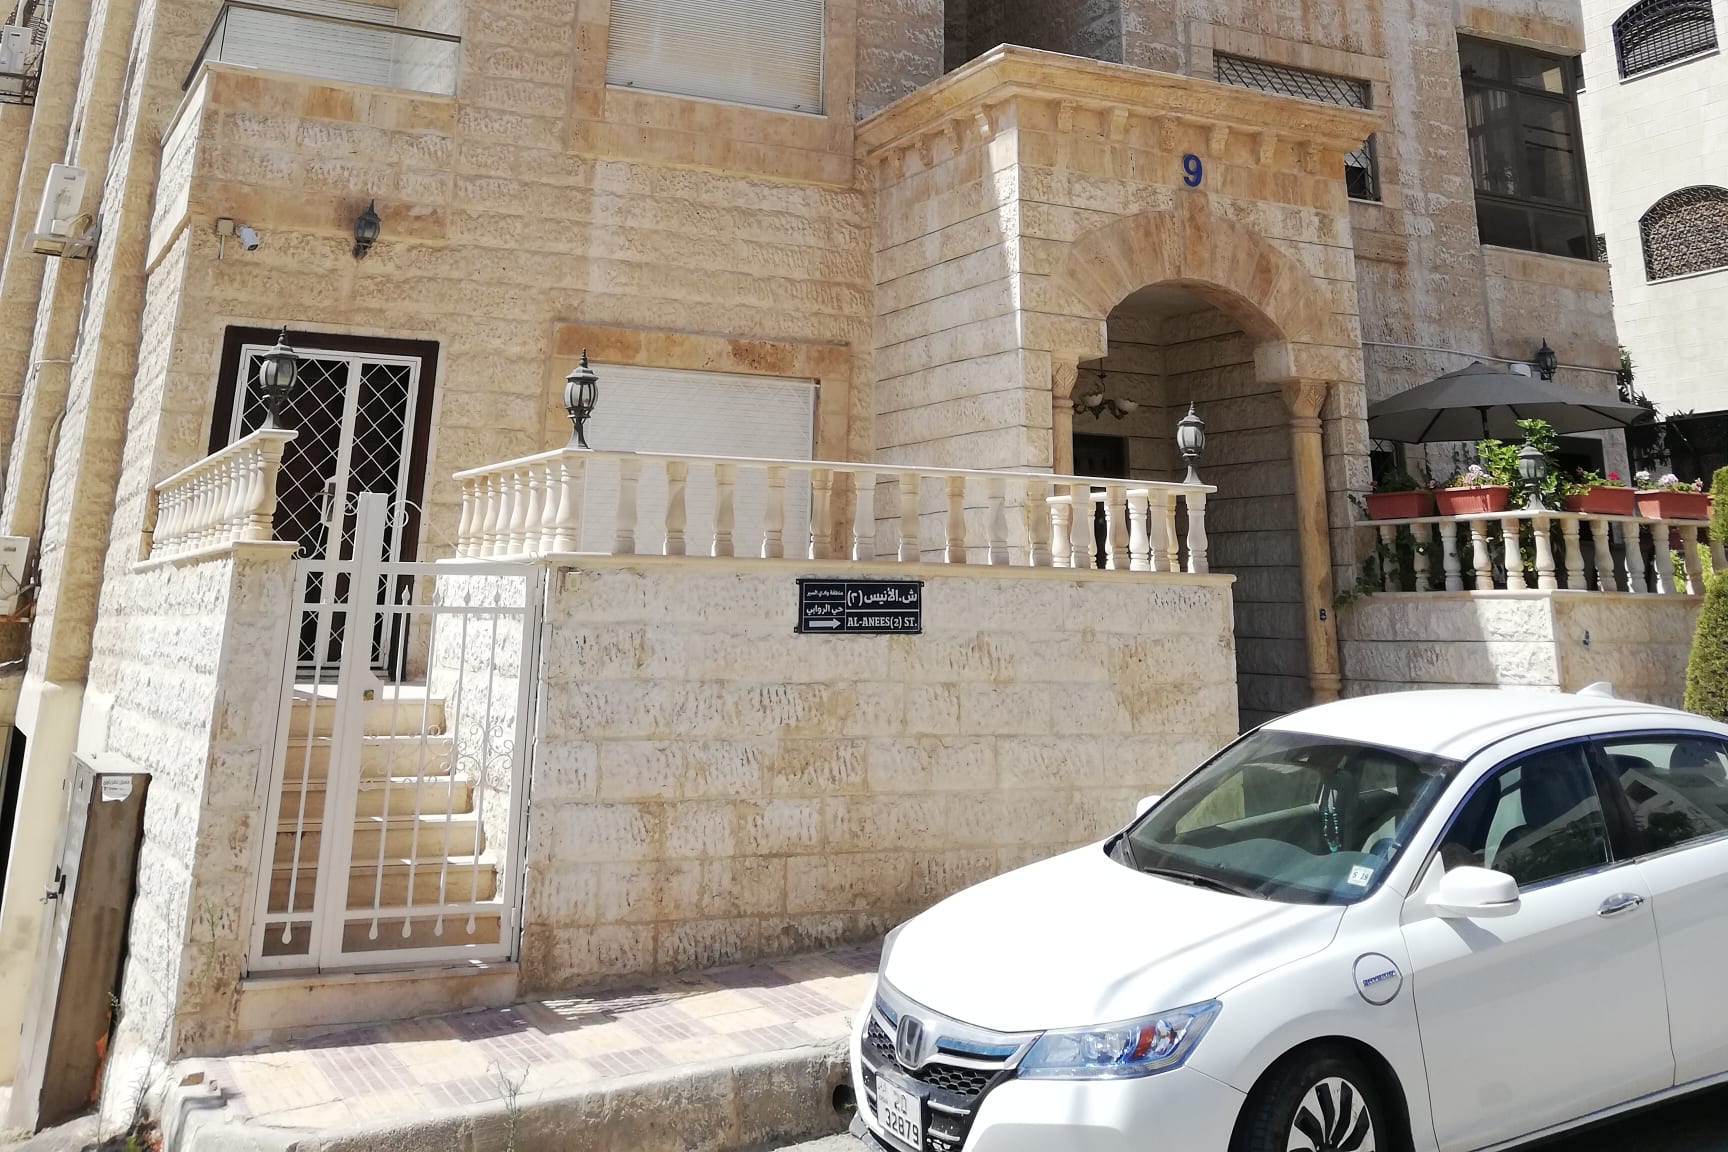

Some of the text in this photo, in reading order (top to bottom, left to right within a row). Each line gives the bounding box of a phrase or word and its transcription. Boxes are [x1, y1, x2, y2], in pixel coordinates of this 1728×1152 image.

[1183, 154, 1203, 188] 9
[806, 604, 843, 615] حي الروابي
[904, 617, 917, 626] ST.
